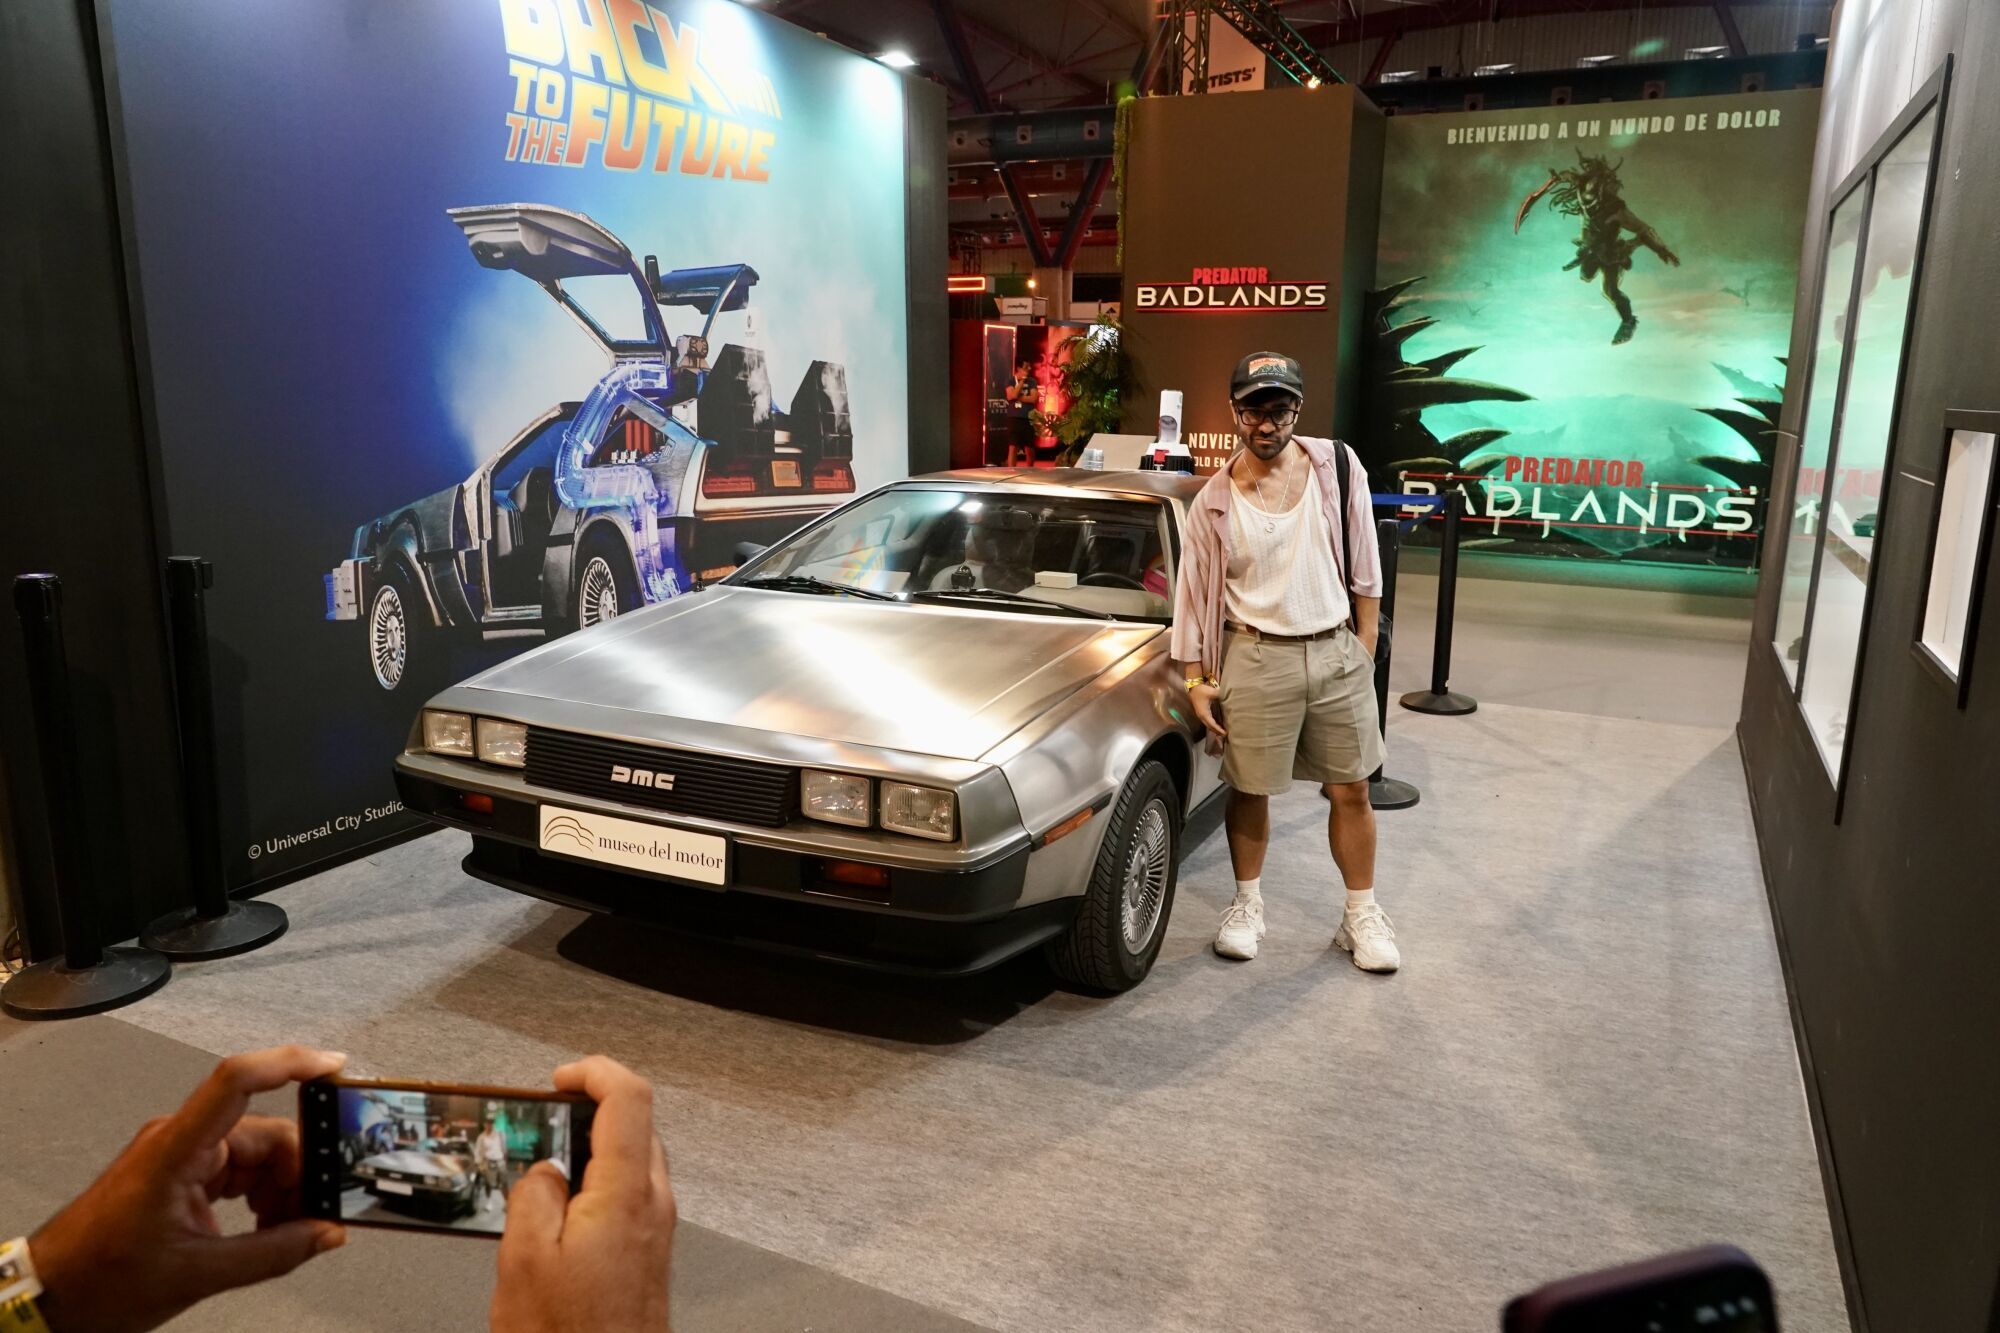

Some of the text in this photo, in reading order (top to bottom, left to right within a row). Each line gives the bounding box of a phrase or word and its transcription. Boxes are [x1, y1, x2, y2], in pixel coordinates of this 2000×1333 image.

[509, 58, 566, 120] TO
[1188, 66, 1257, 93] TISTS'
[505, 76, 777, 184] THE FUTURE
[1447, 109, 1781, 145] BIENVENIDO A UN MUNDO DE DOLOR
[1193, 266, 1269, 285] PREDATOR
[1137, 284, 1327, 307] BADLANDS
[1504, 455, 1645, 489] PREDATOR
[1400, 478, 1758, 536] BADLANDS
[265, 821, 333, 854] Universal
[335, 814, 361, 832] City
[598, 836, 723, 870] museo del motor
